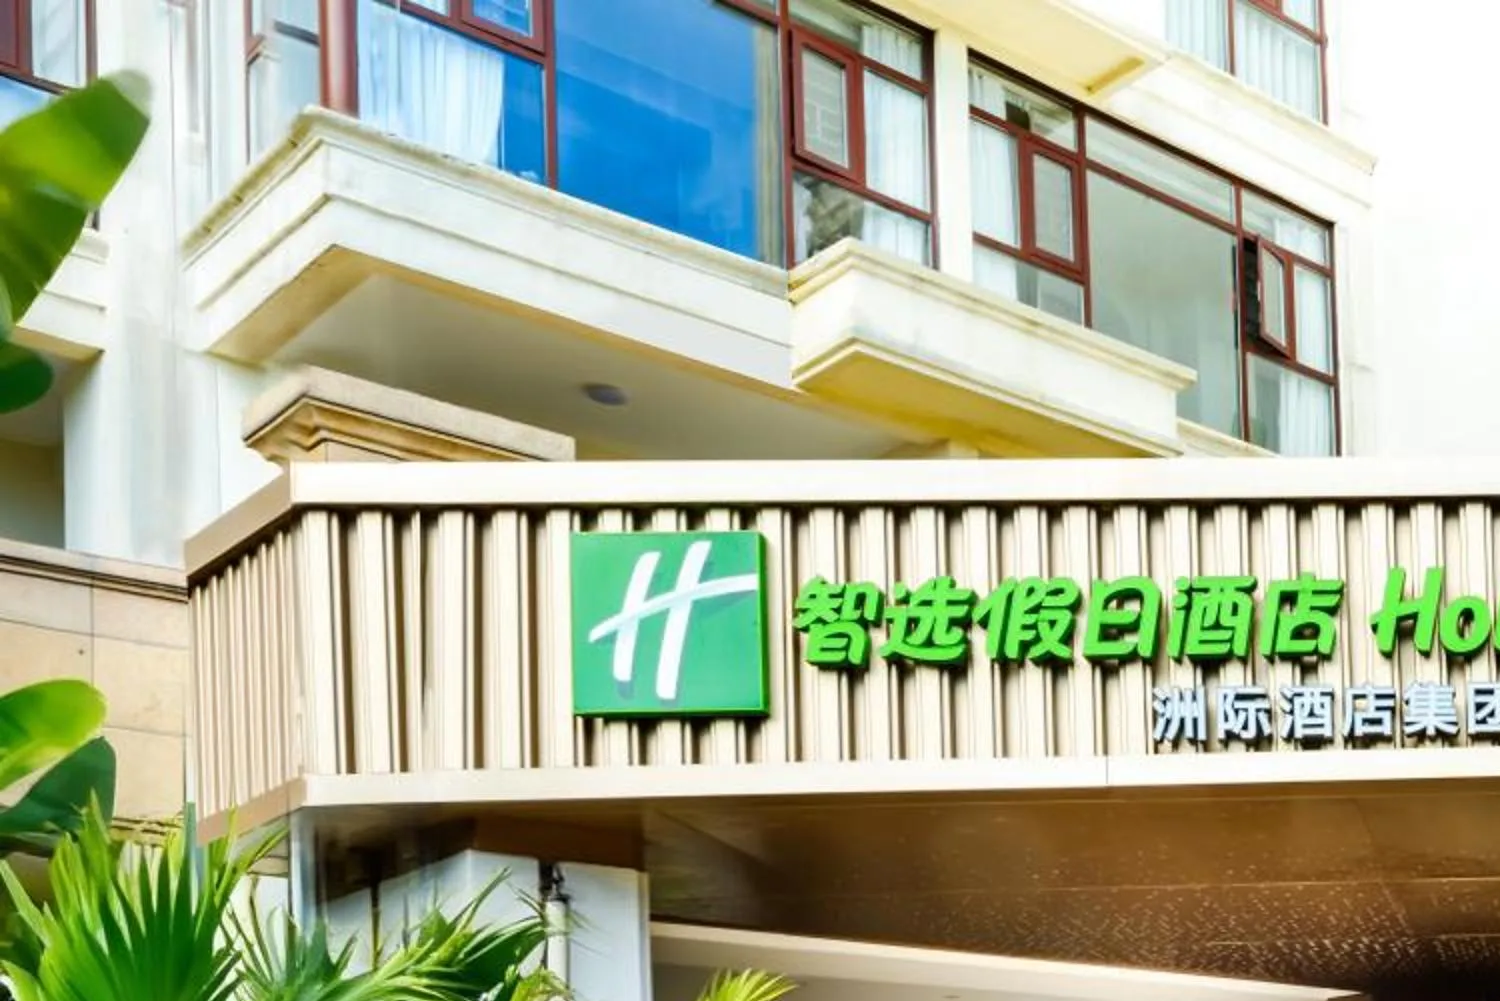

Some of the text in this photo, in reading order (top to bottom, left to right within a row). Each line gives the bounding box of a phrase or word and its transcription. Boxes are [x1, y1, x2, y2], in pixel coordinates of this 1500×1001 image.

[588, 540, 758, 700] H
[793, 573, 1345, 668] 智选假日酒店
